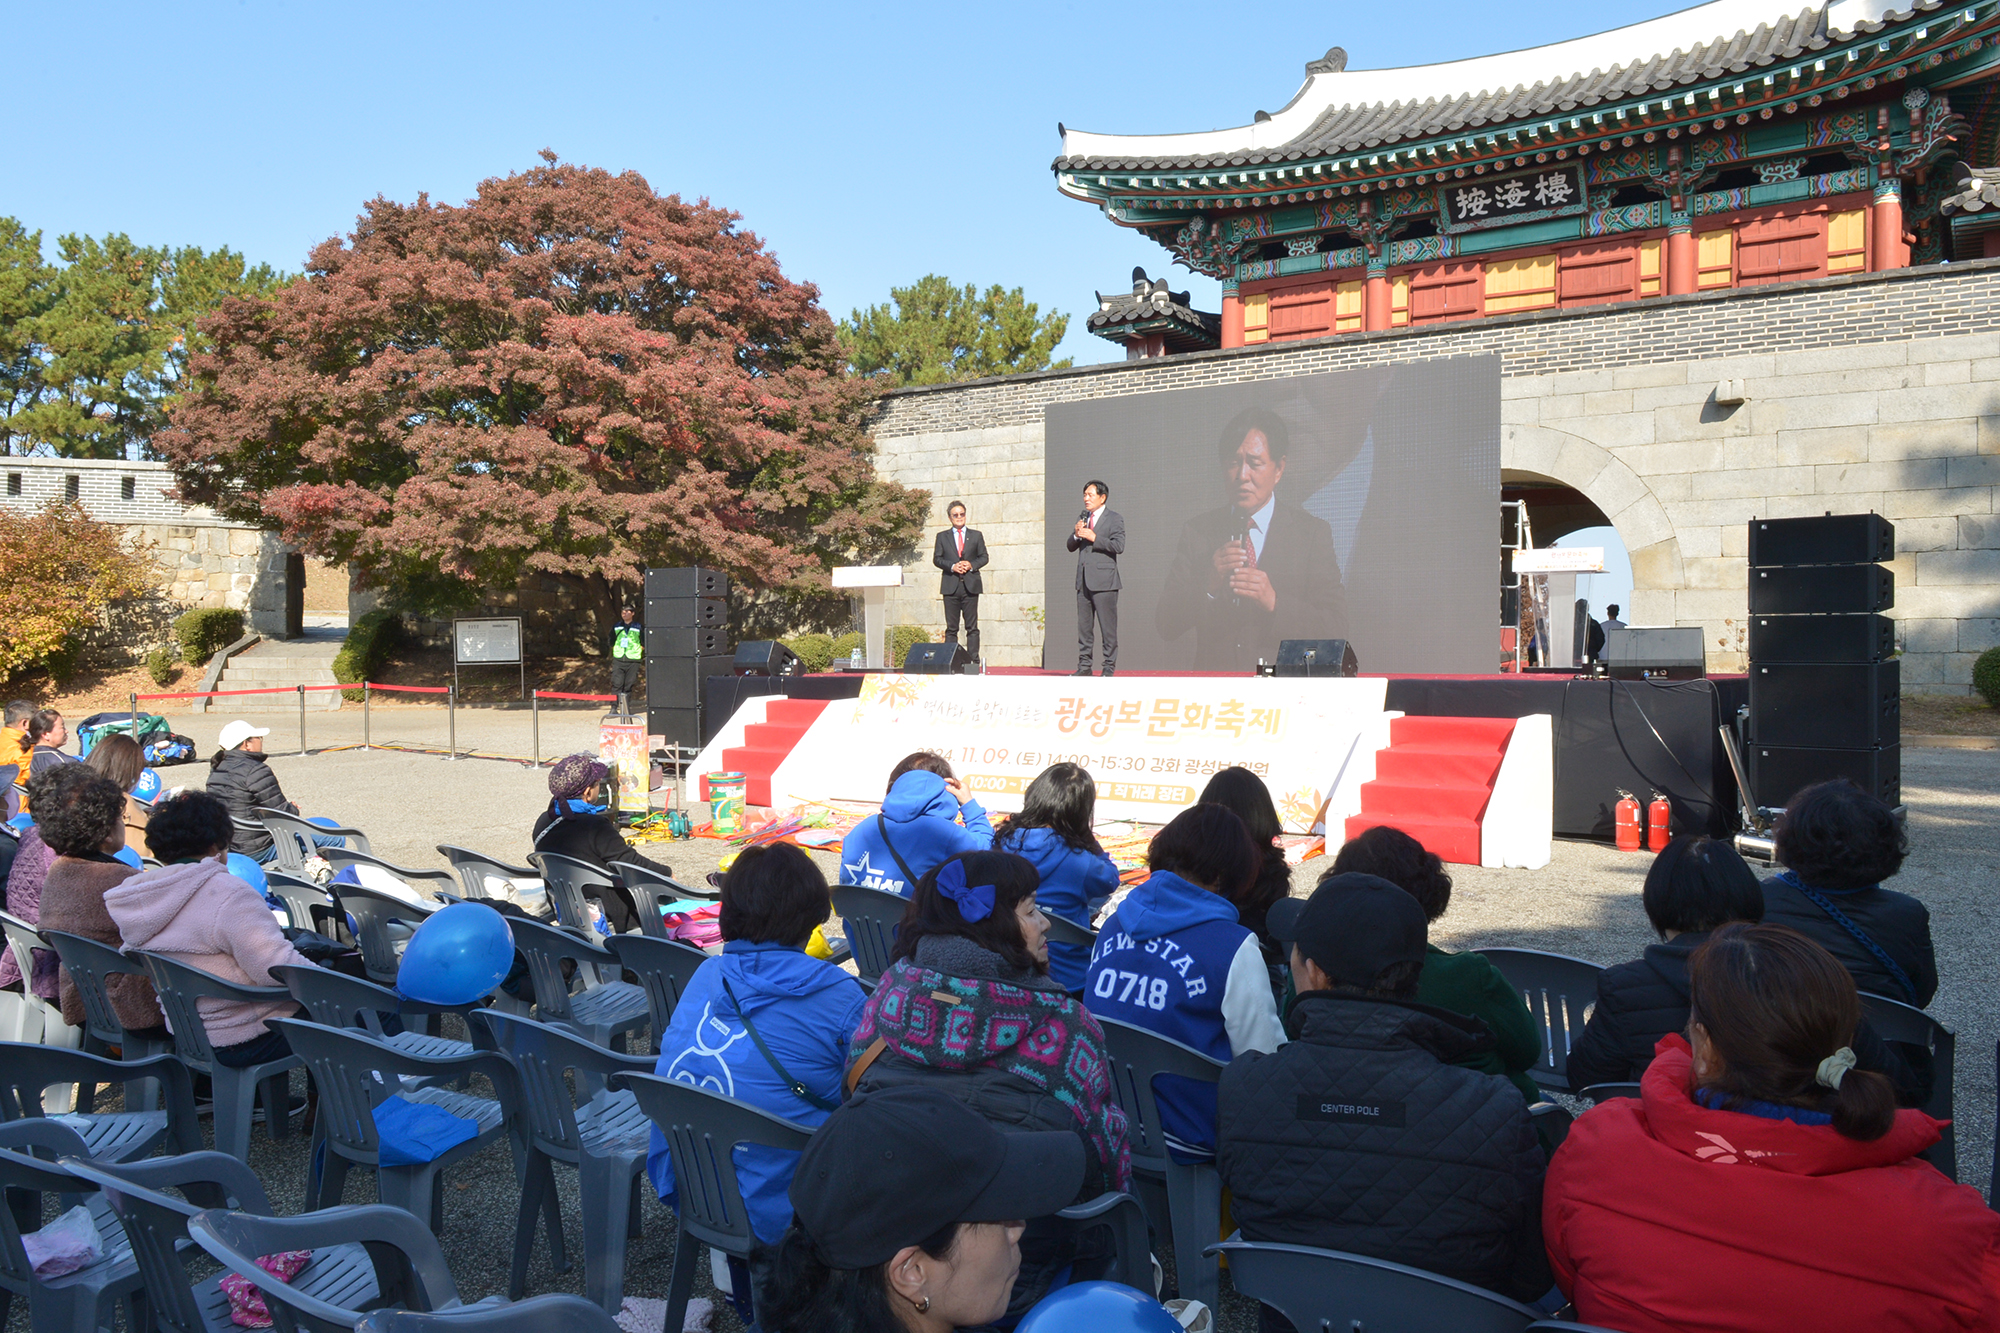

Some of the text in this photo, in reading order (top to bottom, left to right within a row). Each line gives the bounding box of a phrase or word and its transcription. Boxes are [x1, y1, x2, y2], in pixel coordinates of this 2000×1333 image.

[1455, 172, 1573, 219] 按海樓
[1016, 751, 1042, 766] (토)
[1150, 757, 1181, 773] 강화
[969, 775, 1007, 791] 10:00
[1114, 783, 1157, 800] 직거래
[1158, 785, 1187, 802] 장터
[1144, 935, 1208, 999] STAR
[1094, 967, 1169, 1011] 0718
[1320, 1103, 1380, 1116] CENTER POLE
